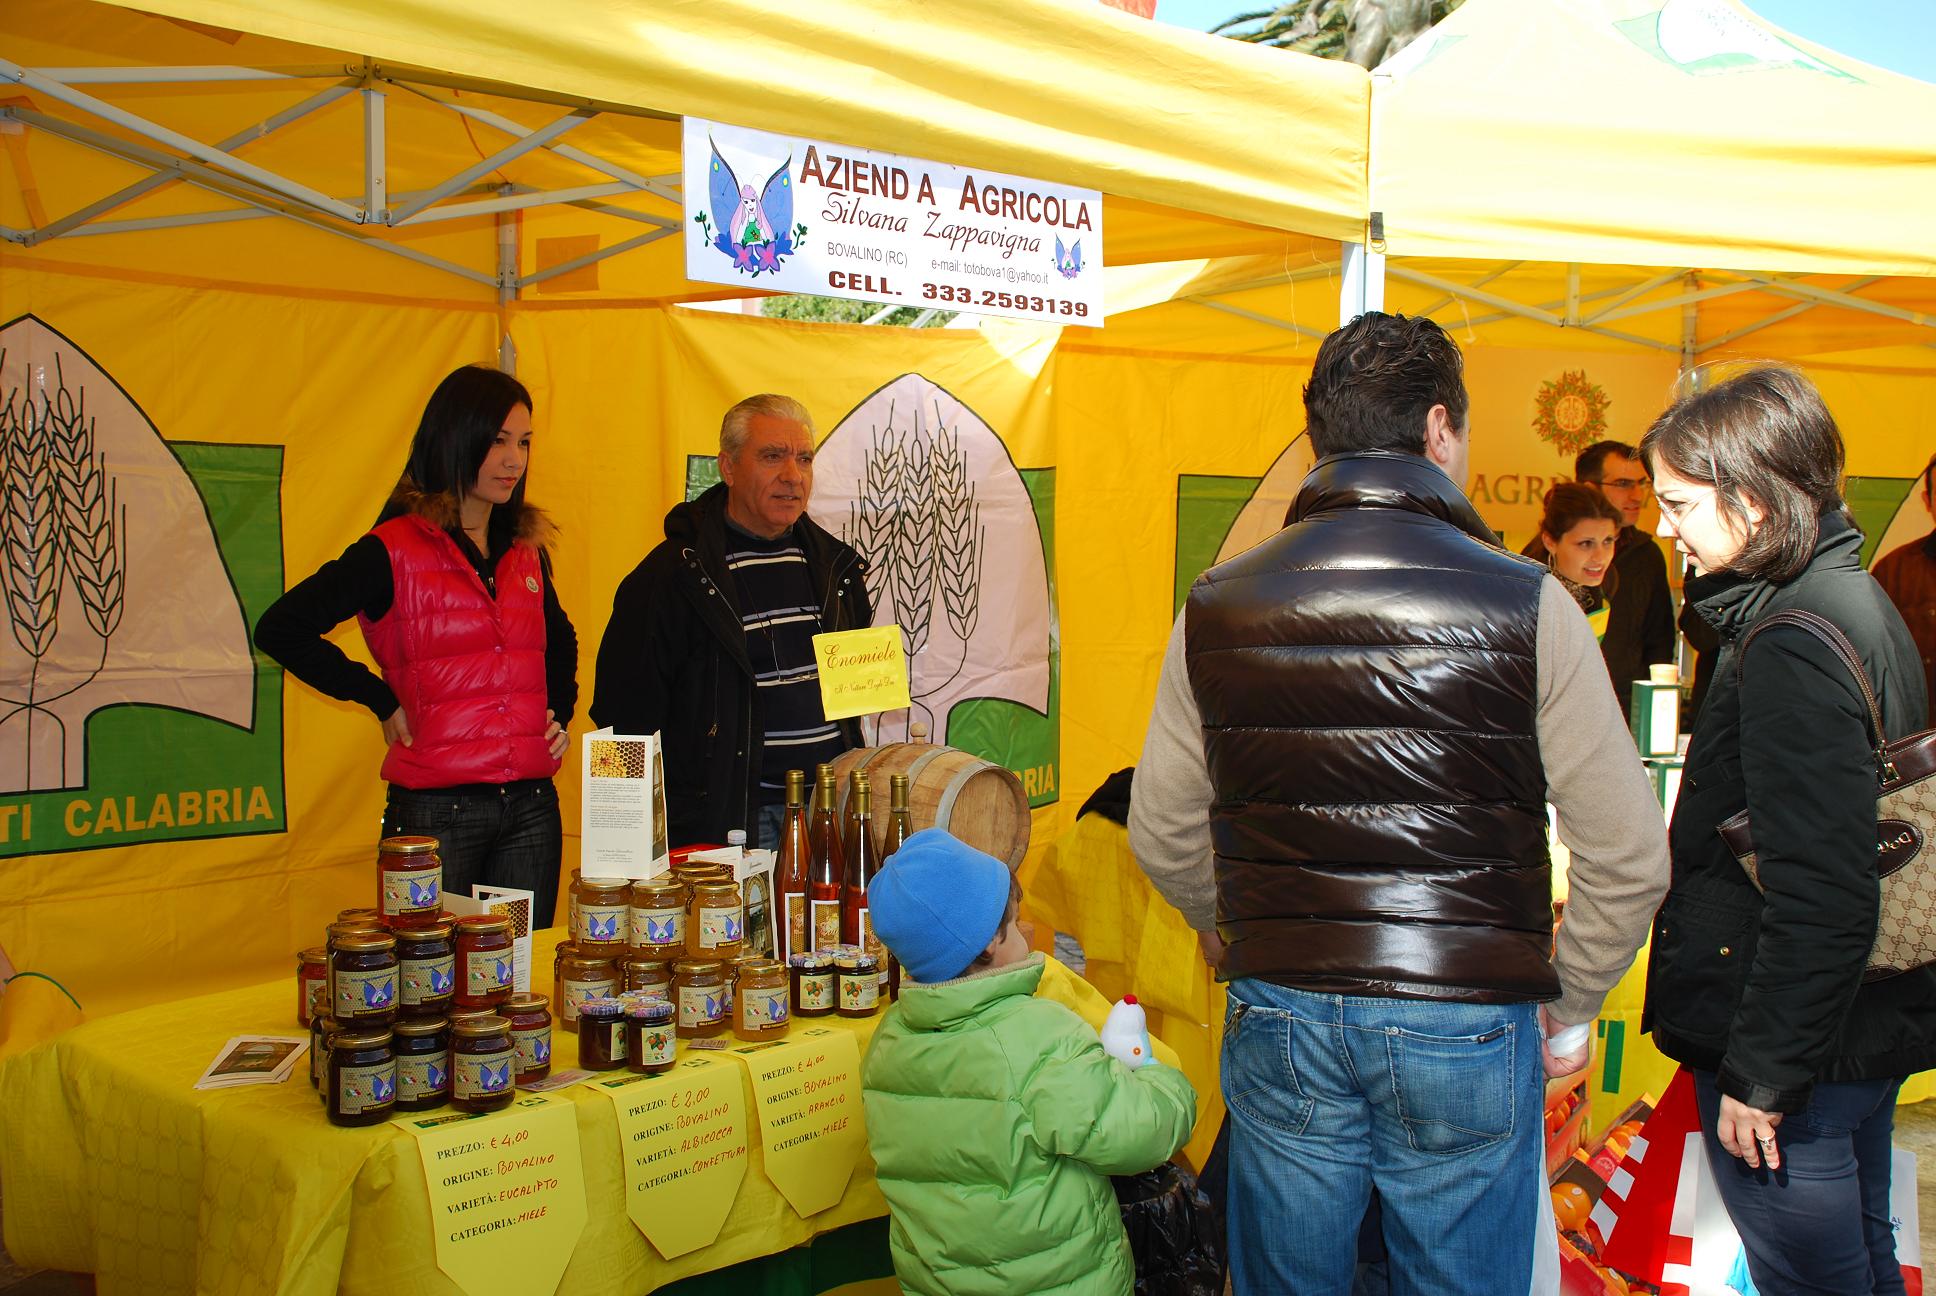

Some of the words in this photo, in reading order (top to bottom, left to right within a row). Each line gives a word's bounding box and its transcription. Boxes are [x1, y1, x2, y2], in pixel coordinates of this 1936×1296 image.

[959, 175, 1092, 231] AGRICOLA
[822, 192, 908, 233] Silvana
[923, 211, 1041, 258] Zappavigna
[828, 242, 882, 264] BOVALINO
[885, 249, 908, 267] (RC)
[931, 259, 961, 273] e-mail:
[963, 261, 1049, 285] totobova1@yahoo.it
[829, 271, 902, 296] CELL.
[923, 283, 1088, 317] 333.2593139
[824, 641, 896, 669] Enomiele
[64, 786, 274, 837] CALABRIA
[762, 1065, 795, 1081] PREZZO:
[767, 1088, 802, 1105] ORIGINE:
[804, 1073, 847, 1095] BOVALINO
[629, 1099, 667, 1117] PREZZO:
[633, 1123, 674, 1142] ORIGINE:
[676, 1104, 729, 1130] BOVALINO
[770, 1109, 806, 1128] VARIETÀ:
[808, 1094, 845, 1115] ARANCIO
[437, 1142, 485, 1160] PREZZO:
[636, 1146, 676, 1167] VARIETÀ:
[680, 1126, 733, 1152] ALBICOCCA
[773, 1130, 821, 1152] CATEGORIA:
[822, 1117, 849, 1137] MIELE
[443, 1168, 493, 1187] ORIGINE:
[497, 1154, 555, 1175] BOVALINO
[637, 1167, 692, 1192] CATEGORIA:
[692, 1146, 746, 1174] CONFETTURA
[447, 1192, 497, 1214] VARIETÀ:
[500, 1179, 558, 1201] EUCALIPTO
[450, 1217, 517, 1242] CATEGORIA:
[518, 1206, 548, 1223] MIELE
